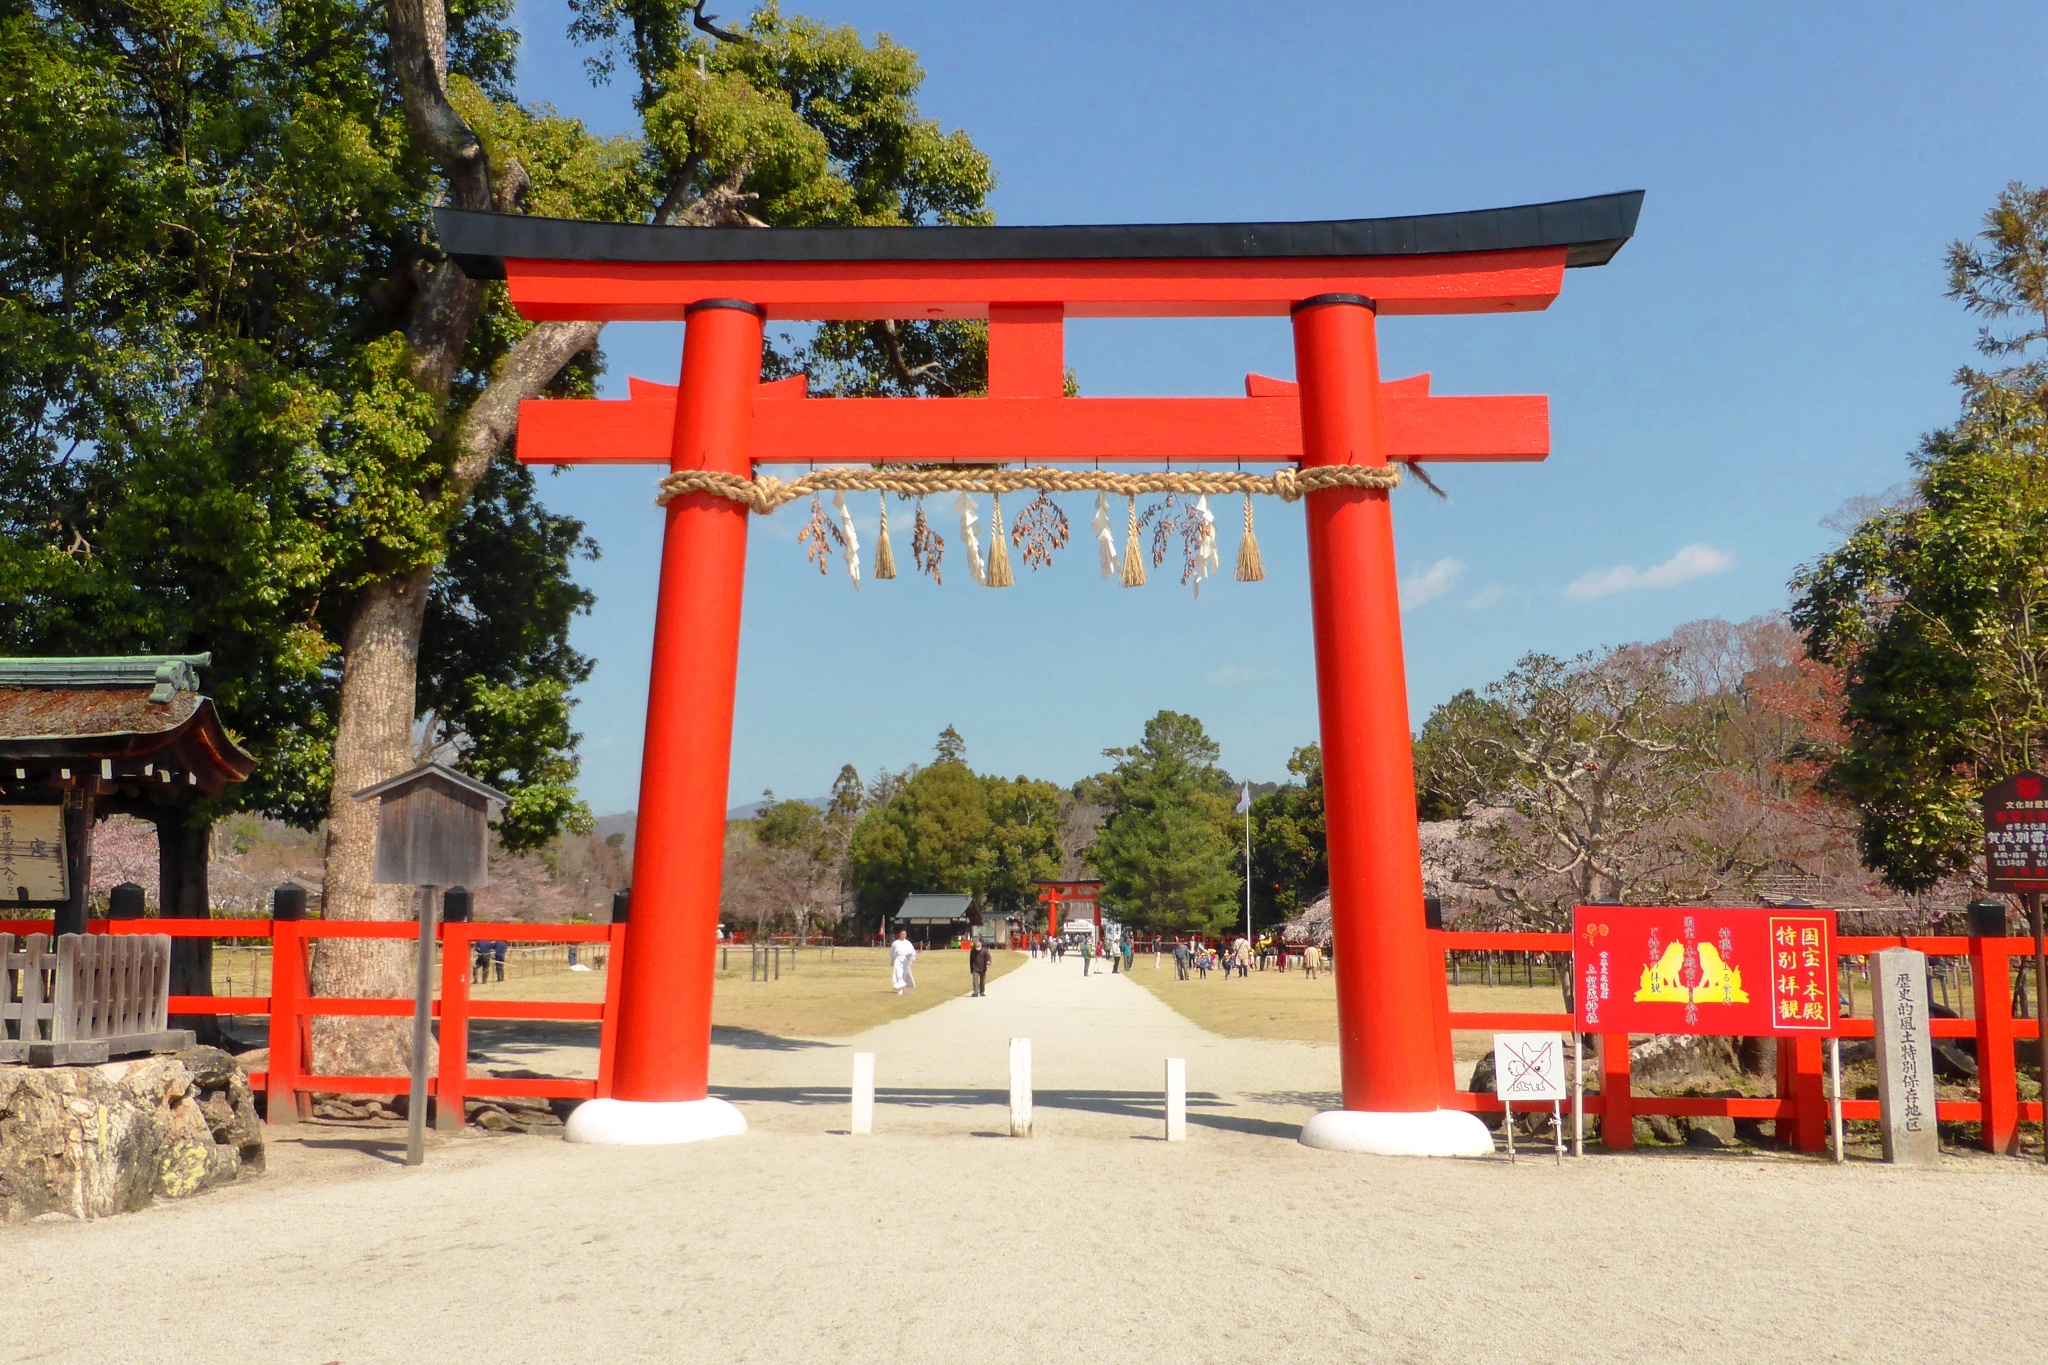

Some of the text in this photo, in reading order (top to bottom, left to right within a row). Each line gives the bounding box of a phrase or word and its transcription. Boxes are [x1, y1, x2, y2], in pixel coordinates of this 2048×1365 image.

[1987, 831, 2048, 844] 賀茂別雷
[1585, 964, 1599, 1025] 上賀茂神社
[1683, 916, 1698, 1026] 国宝・本殿前に参拝
[1775, 925, 1802, 1020] 特別拝観
[1801, 927, 1825, 1021] 国宝・本殿
[1895, 973, 1922, 1132] 歴史的風土特別保存地区
